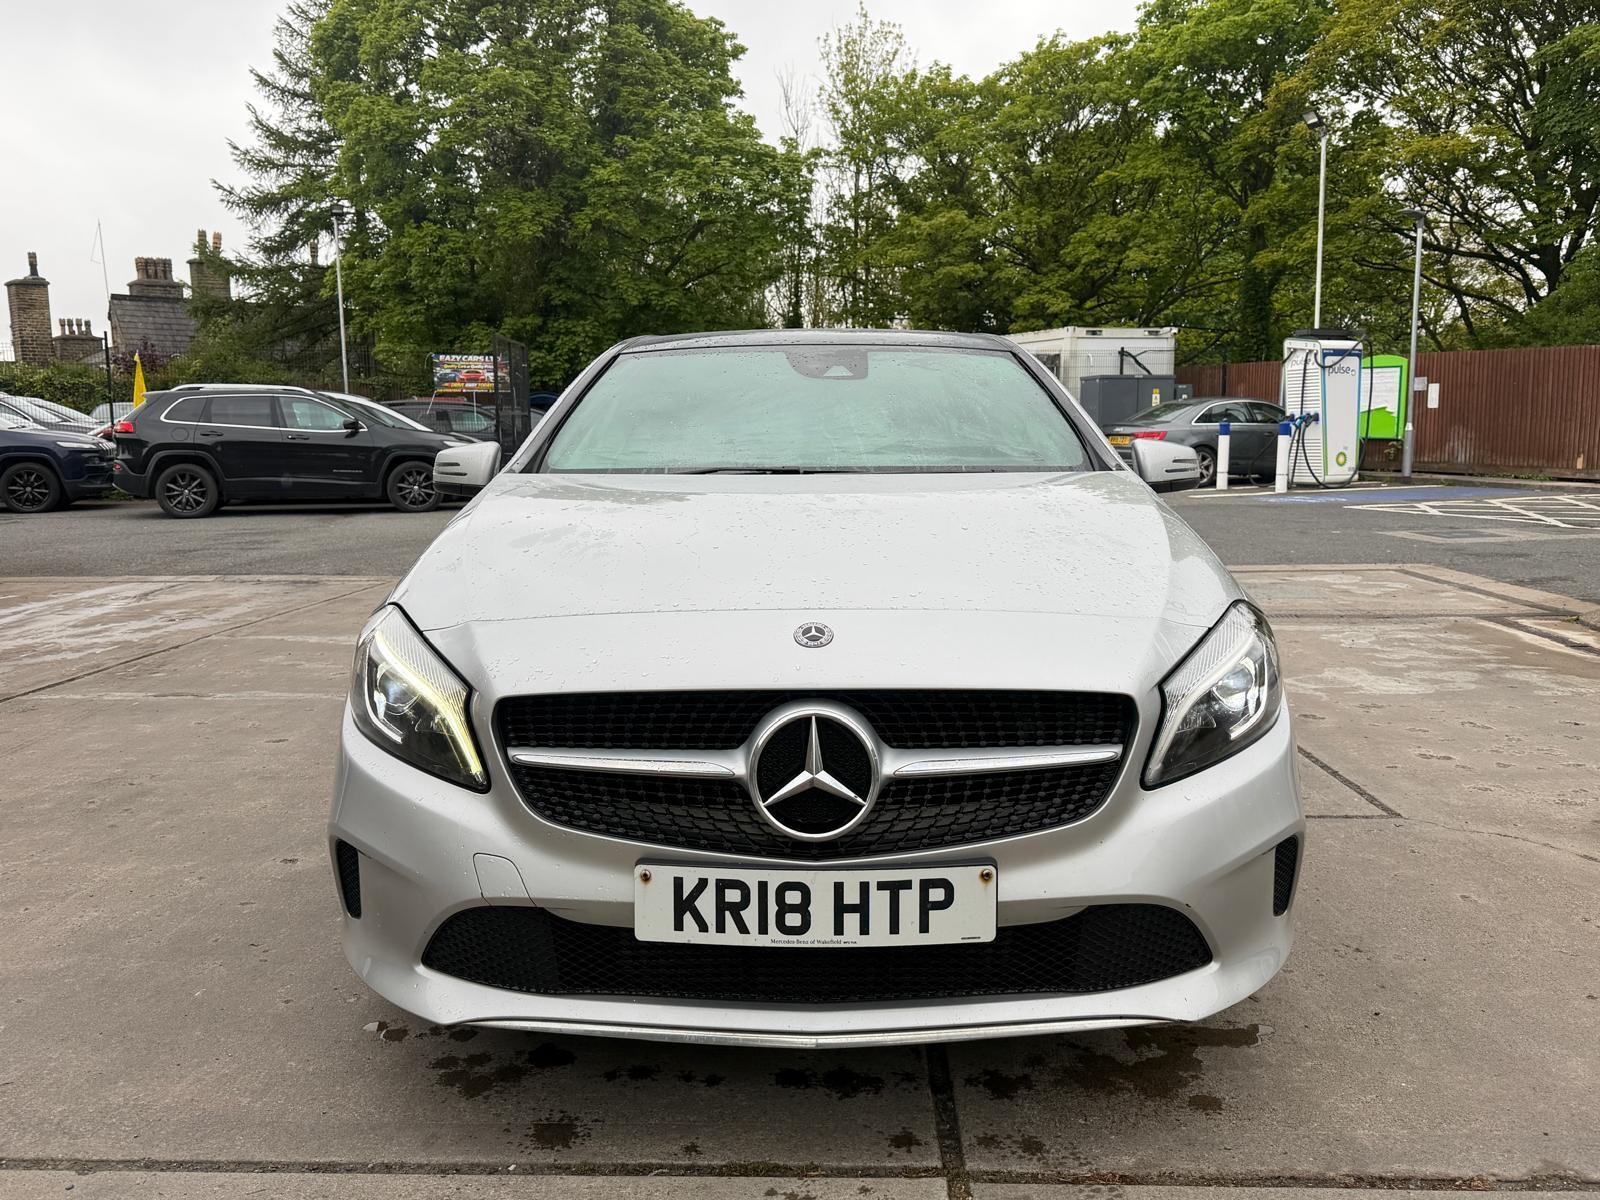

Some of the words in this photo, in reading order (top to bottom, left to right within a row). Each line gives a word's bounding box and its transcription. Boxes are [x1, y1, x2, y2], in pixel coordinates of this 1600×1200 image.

[439, 354, 463, 362] EAZY
[1328, 365, 1351, 376] pulse
[672, 876, 812, 936] KR18
[833, 877, 955, 936] HTP
